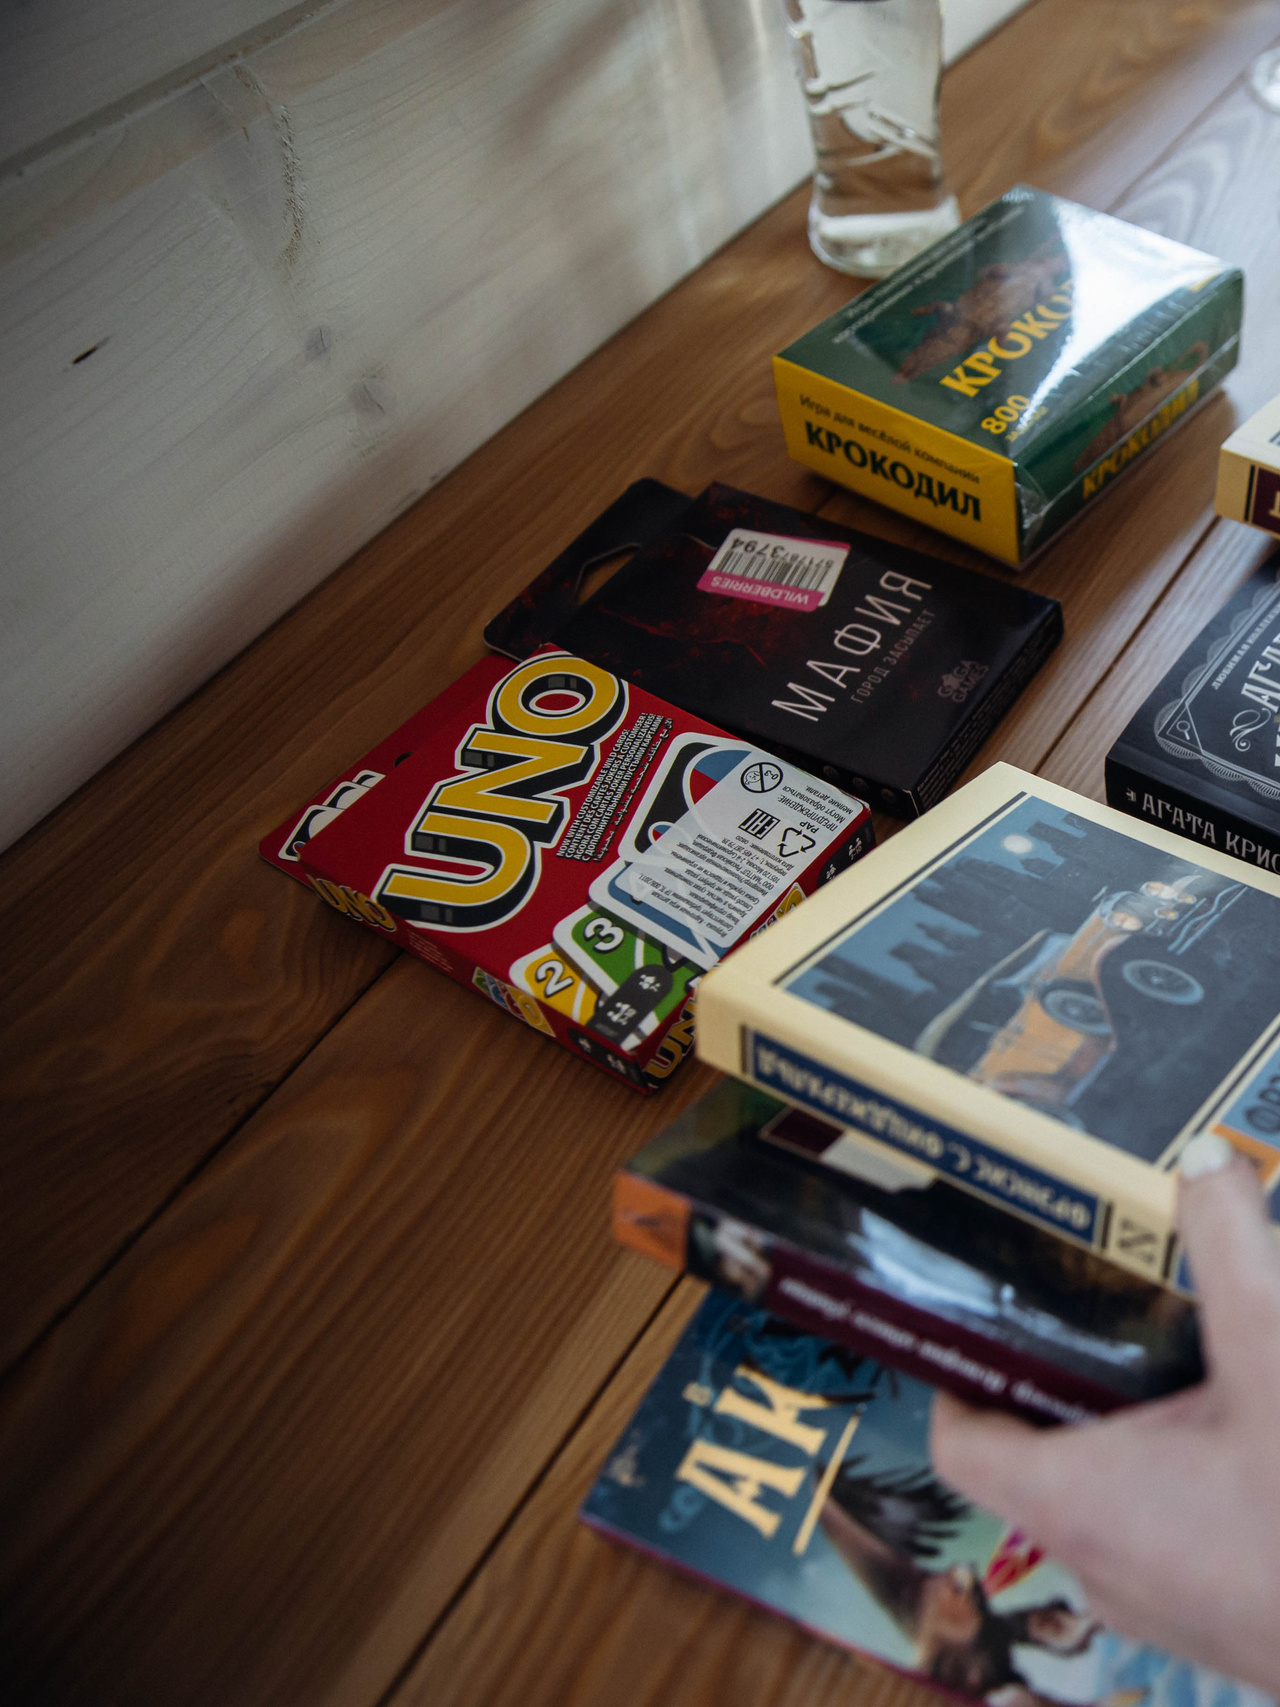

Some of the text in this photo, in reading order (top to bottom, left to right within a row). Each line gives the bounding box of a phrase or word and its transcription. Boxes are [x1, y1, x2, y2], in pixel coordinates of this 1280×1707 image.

[981, 394, 1032, 435] 800
[799, 393, 830, 421] Игра
[832, 409, 854, 430] для
[914, 446, 979, 485] компании
[805, 418, 980, 530] КРОКОДИЛ
[708, 575, 811, 604] WILDBERRIES
[771, 569, 934, 722] МАФИЯ
[848, 608, 938, 705] ГОРОД ЗАСЫПАЕТ
[1211, 643, 1250, 690] ЛЮБИМАЯ
[583, 778, 630, 856] ДОПОЛНИТЕЛЬНЫМИ
[622, 746, 646, 779] ПУСТЫМИ
[640, 714, 663, 747] КАРТАМИ!
[762, 769, 779, 780] 0-3
[372, 651, 630, 934] UNO
[555, 835, 573, 857] NOW
[566, 819, 581, 835] WITH
[575, 768, 608, 819] CUSTOMIZABLE
[602, 752, 617, 768] WILD
[612, 728, 630, 751] CARDS!
[563, 822, 589, 858] CONTIENT
[582, 809, 595, 822] DES
[589, 783, 609, 809] CARTES
[603, 759, 621, 783] JOKERS
[619, 715, 645, 754] CUSTOMISER
[780, 784, 847, 823] Могут образоваться
[802, 784, 854, 814] мелкие детали.
[572, 833, 592, 859] AGORA
[586, 817, 600, 834] COM
[594, 790, 614, 817] CARTAS
[608, 769, 625, 791] JOKER
[774, 793, 839, 832] ПРЕДУПРЕЖДЕНИЕ:
[1142, 792, 1216, 844] АГАТА
[797, 819, 820, 833] PAP
[733, 844, 744, 852] 287
[741, 849, 753, 857] 495
[748, 842, 782, 863] изготовления:
[750, 853, 760, 861] +7
[714, 853, 742, 871] Российская
[742, 859, 765, 874] Москва,
[779, 860, 794, 871] Дата
[696, 875, 717, 889] требует
[702, 868, 724, 883] годности
[761, 869, 781, 883] 105120
[761, 879, 775, 890] ООО
[692, 882, 708, 893] сухих
[724, 881, 747, 896] службы
[742, 892, 761, 905] Сроки
[306, 874, 397, 932] UNO
[668, 899, 681, 909] игра
[670, 890, 704, 913] требованиям
[724, 901, 748, 918] Хранить
[734, 898, 754, 911] Способ
[677, 905, 705, 924] Карточная
[698, 907, 735, 931] Соответствует
[724, 912, 741, 924] Товар
[583, 918, 625, 954] 3
[704, 921, 728, 938] Игрушка
[536, 958, 574, 998] 2
[642, 997, 695, 1088] UN
